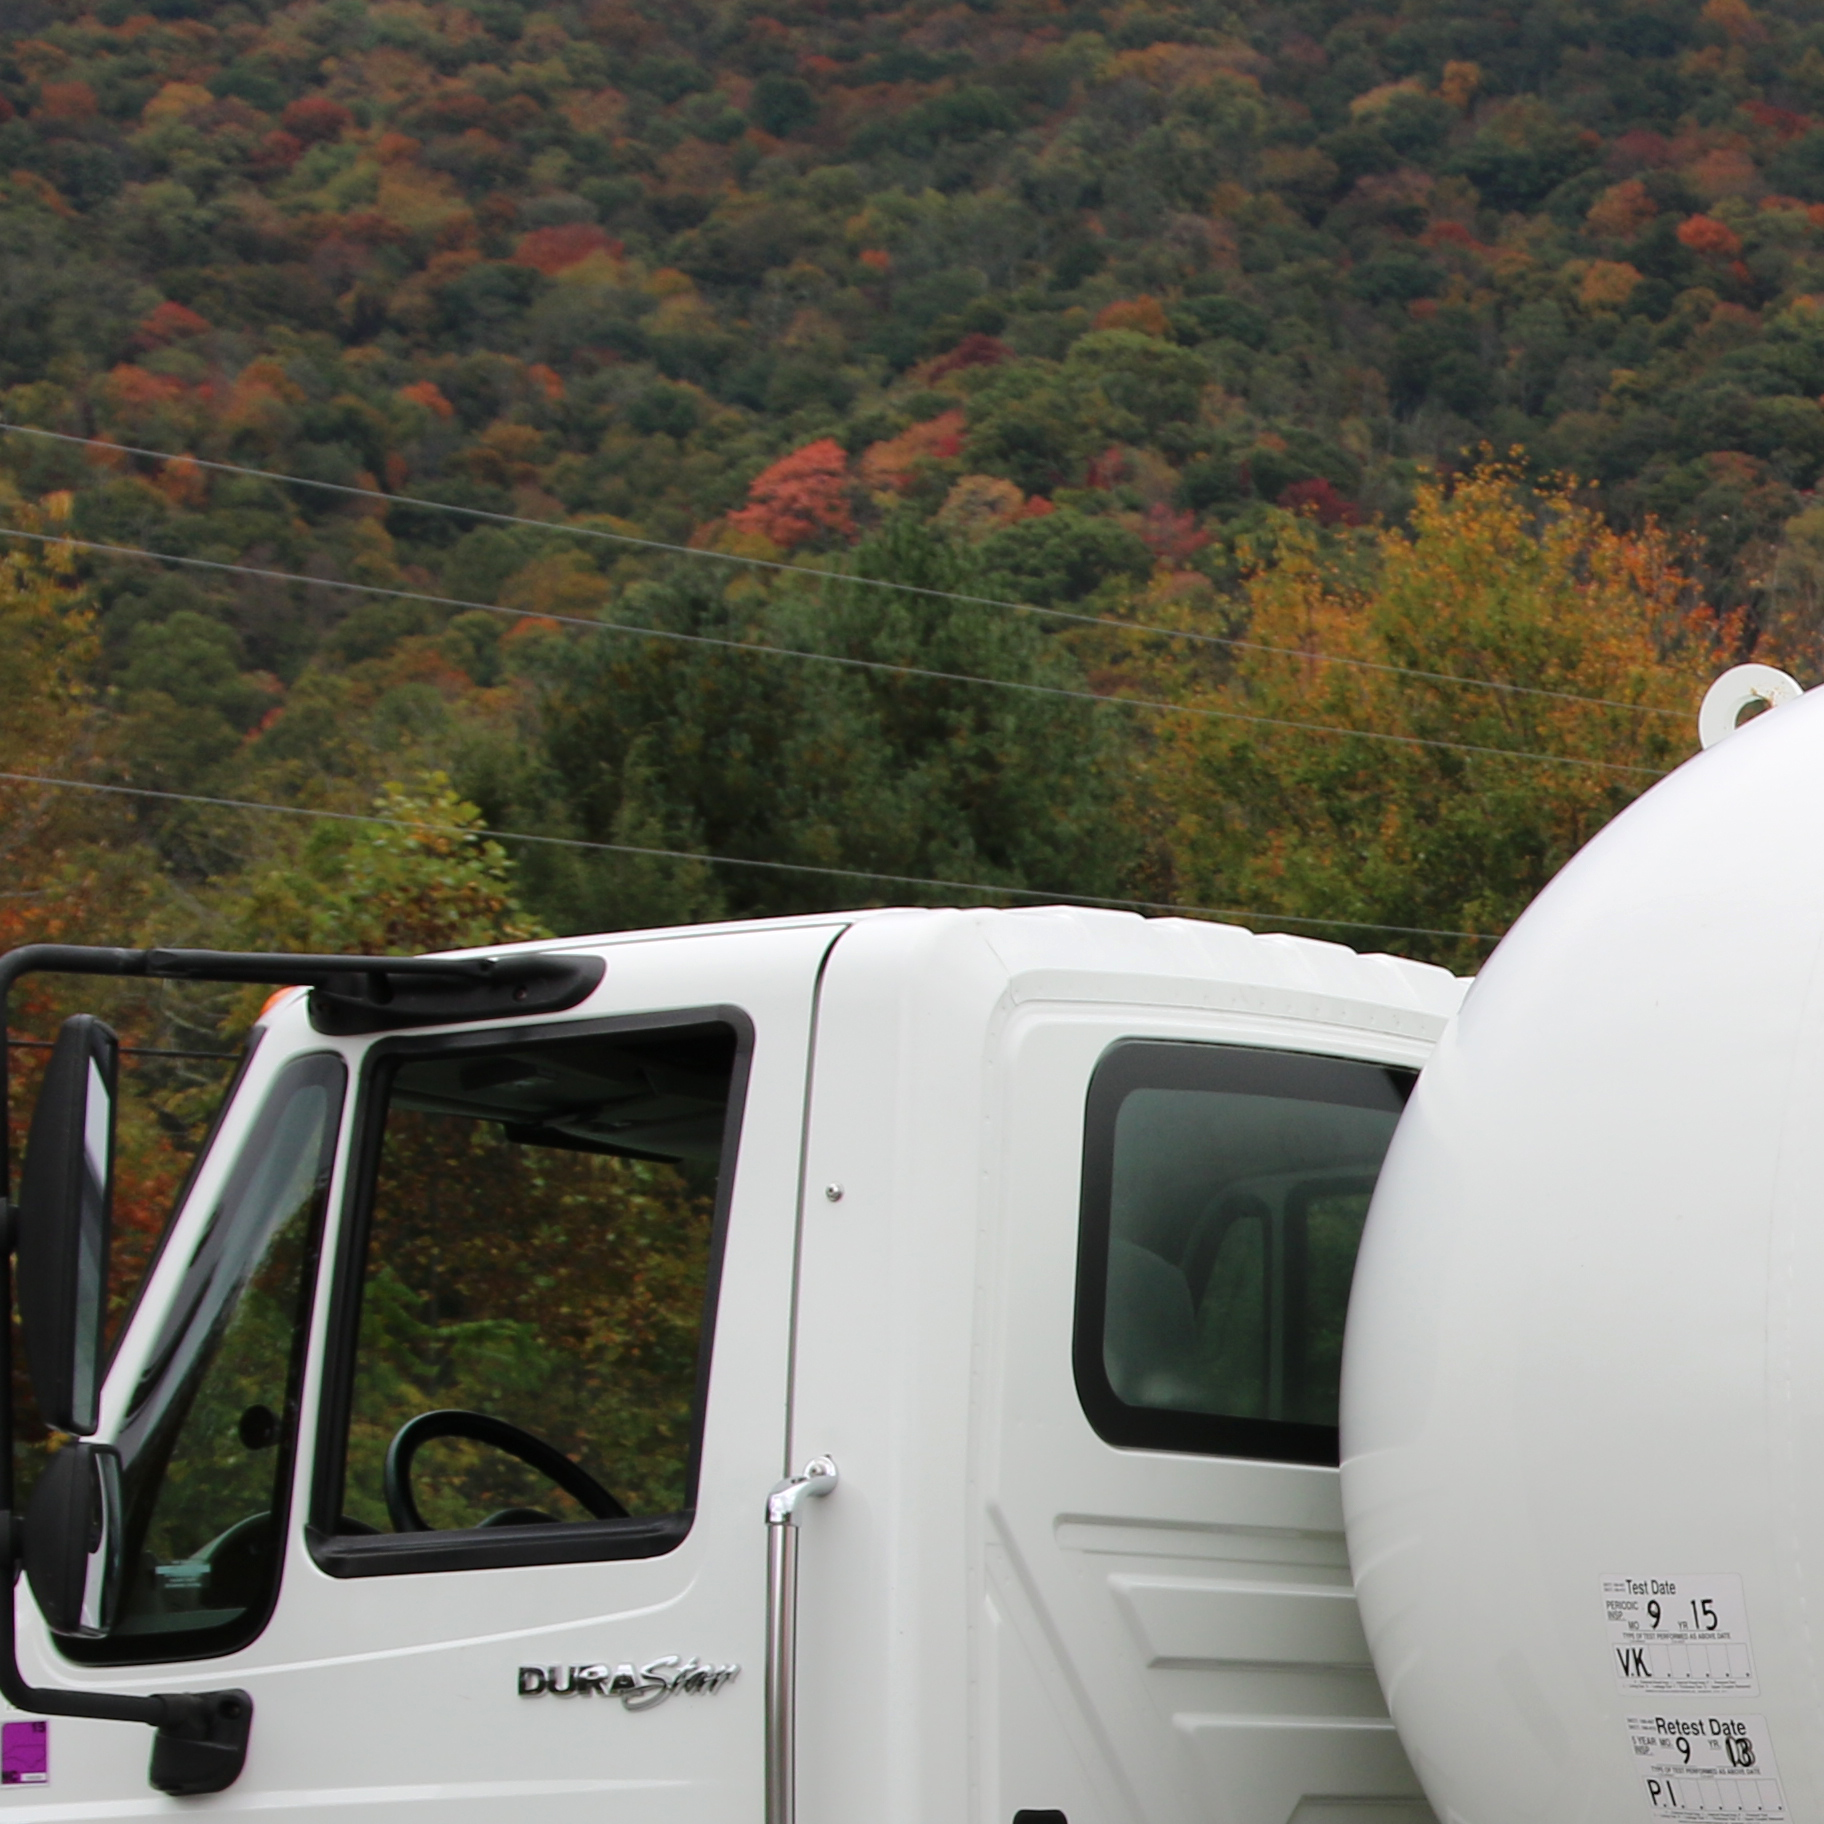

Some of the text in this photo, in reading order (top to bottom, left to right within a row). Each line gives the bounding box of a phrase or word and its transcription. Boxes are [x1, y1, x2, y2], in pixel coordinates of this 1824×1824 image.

[1625, 1580, 1649, 1595] Test
[1651, 1580, 1676, 1595] Date
[1647, 1600, 1661, 1629] 9
[1691, 1599, 1718, 1631] 15
[1655, 1717, 1706, 1736] Retest
[1708, 1718, 1747, 1737] Date
[1676, 1737, 1691, 1764] 9
